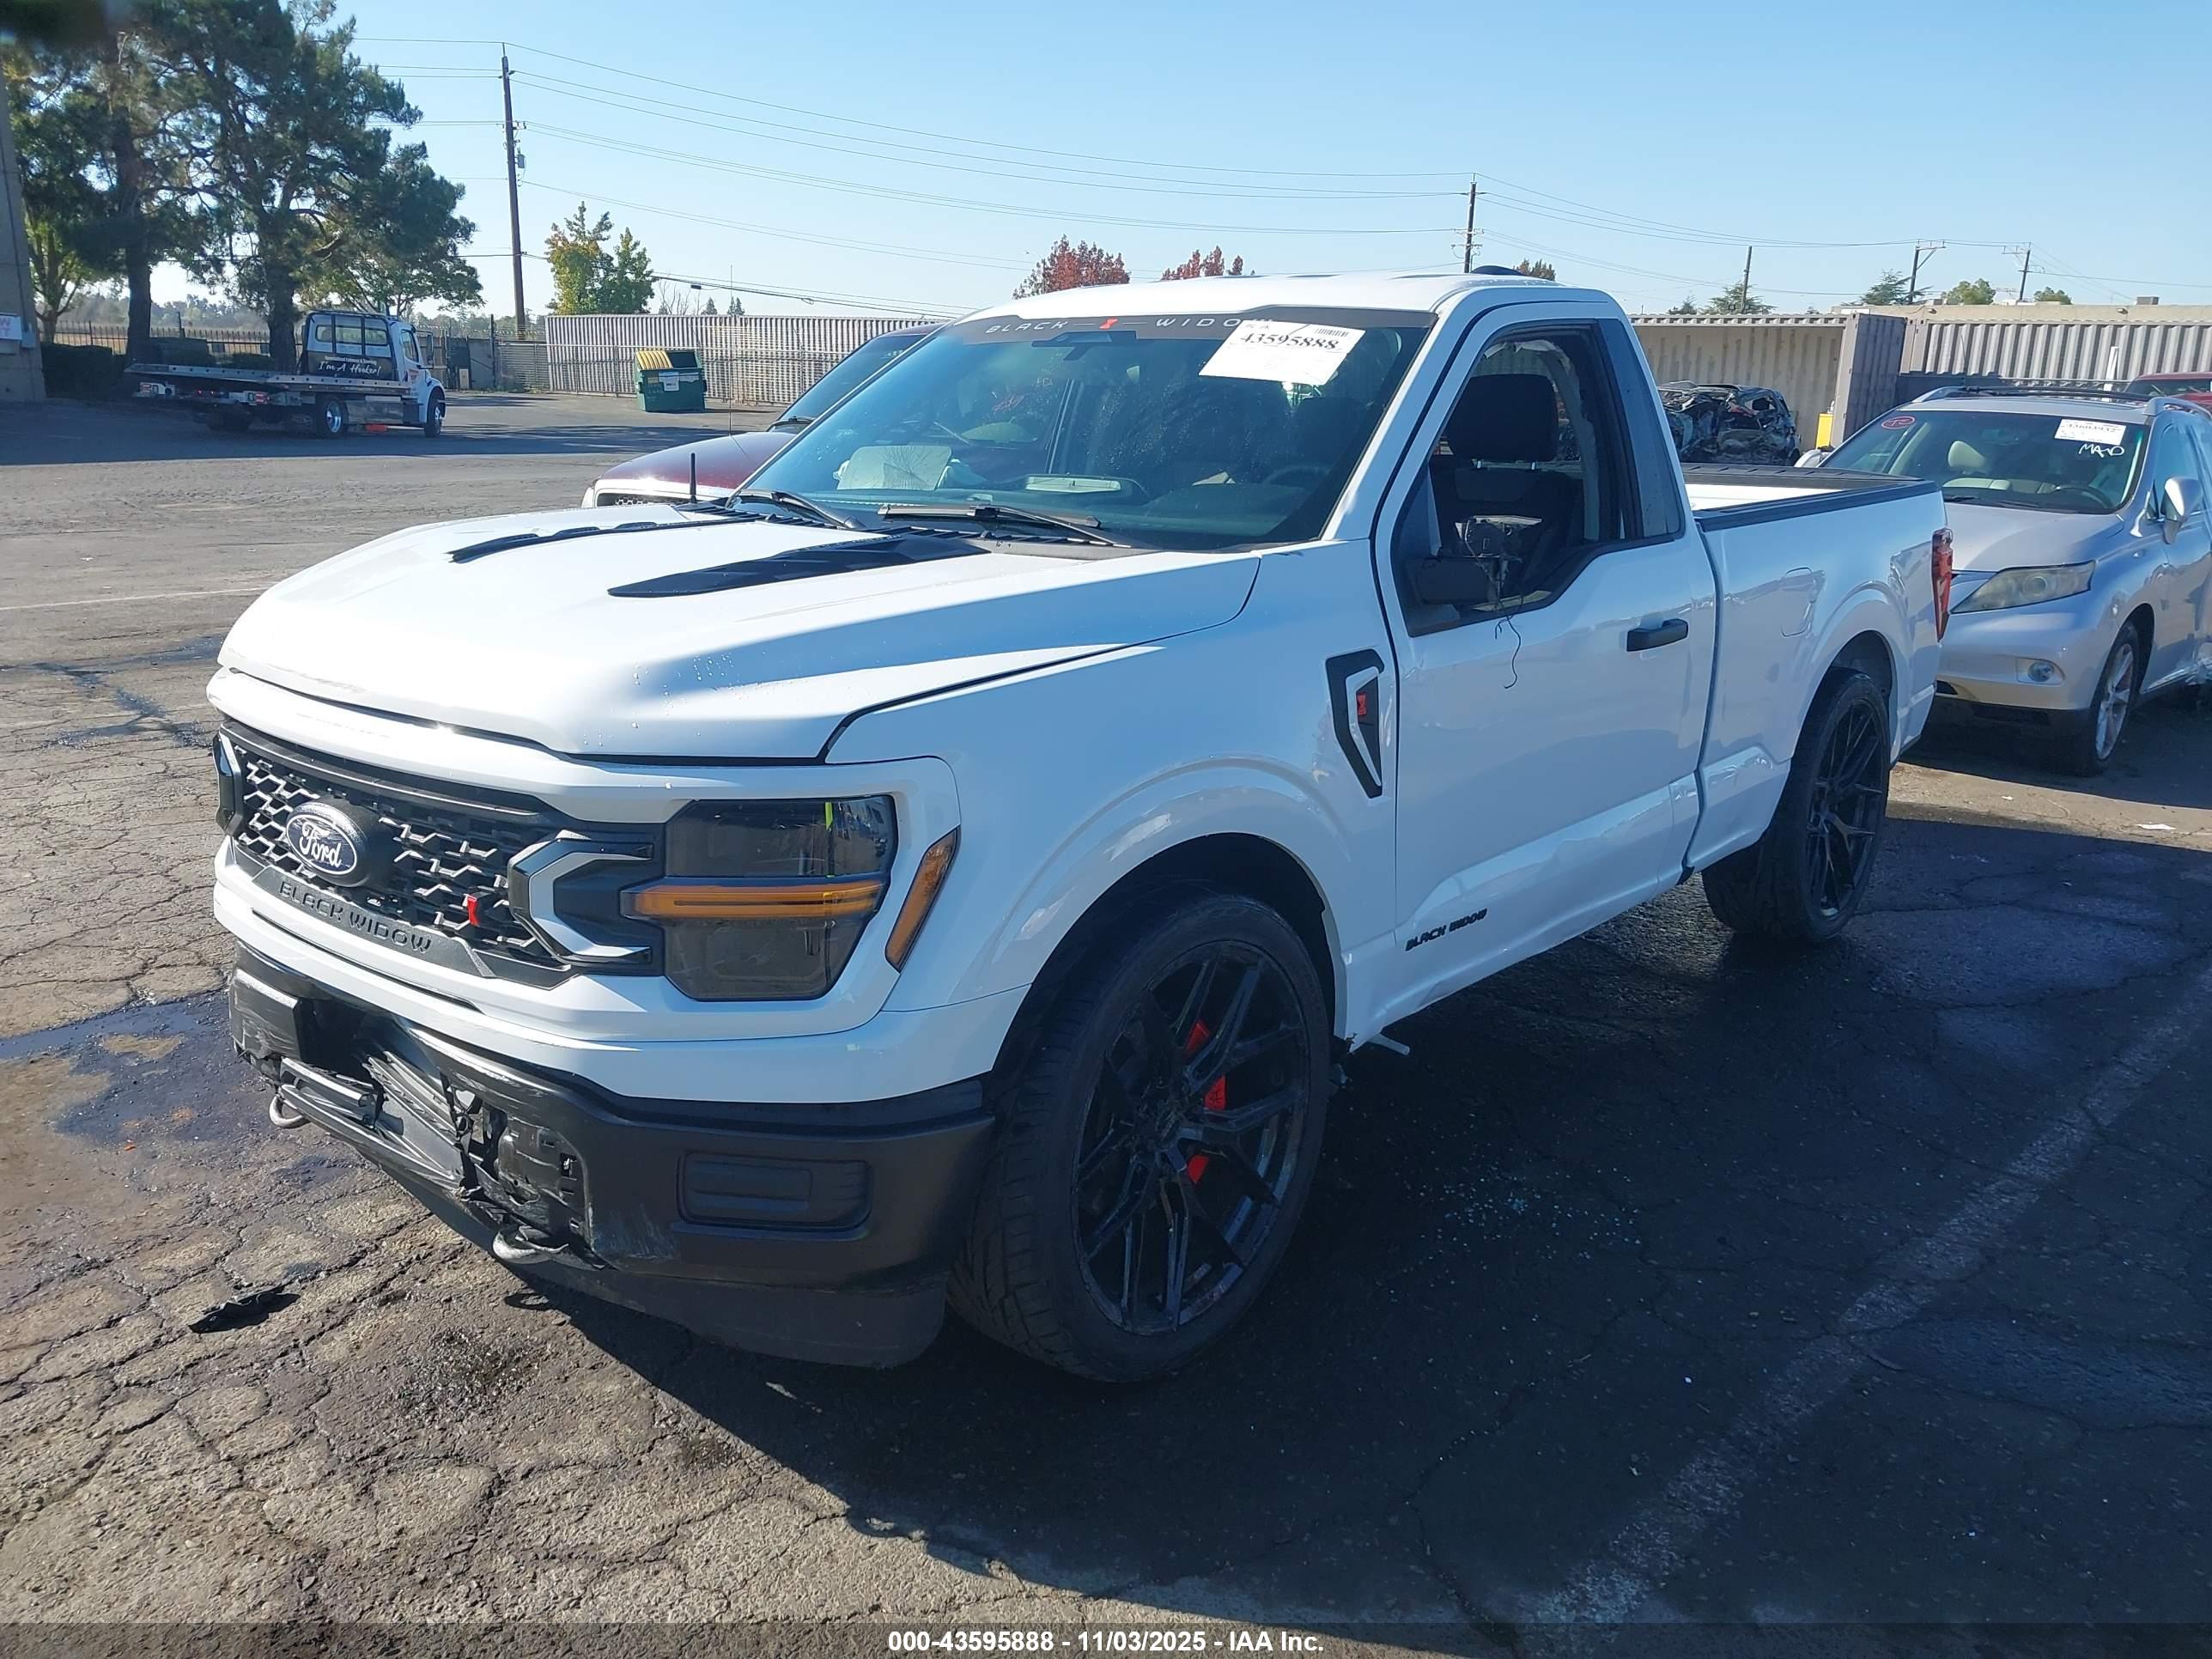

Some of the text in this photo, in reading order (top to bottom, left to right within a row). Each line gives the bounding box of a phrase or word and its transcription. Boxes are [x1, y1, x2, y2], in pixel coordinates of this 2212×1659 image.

[985, 320, 1069, 334] BLACK
[1155, 318, 1273, 329] WIDO
[1240, 333, 1339, 349] 43595888
[299, 821, 343, 868] Ford
[279, 880, 432, 954] BLACK WIDOW
[1405, 925, 1447, 951] BLACK
